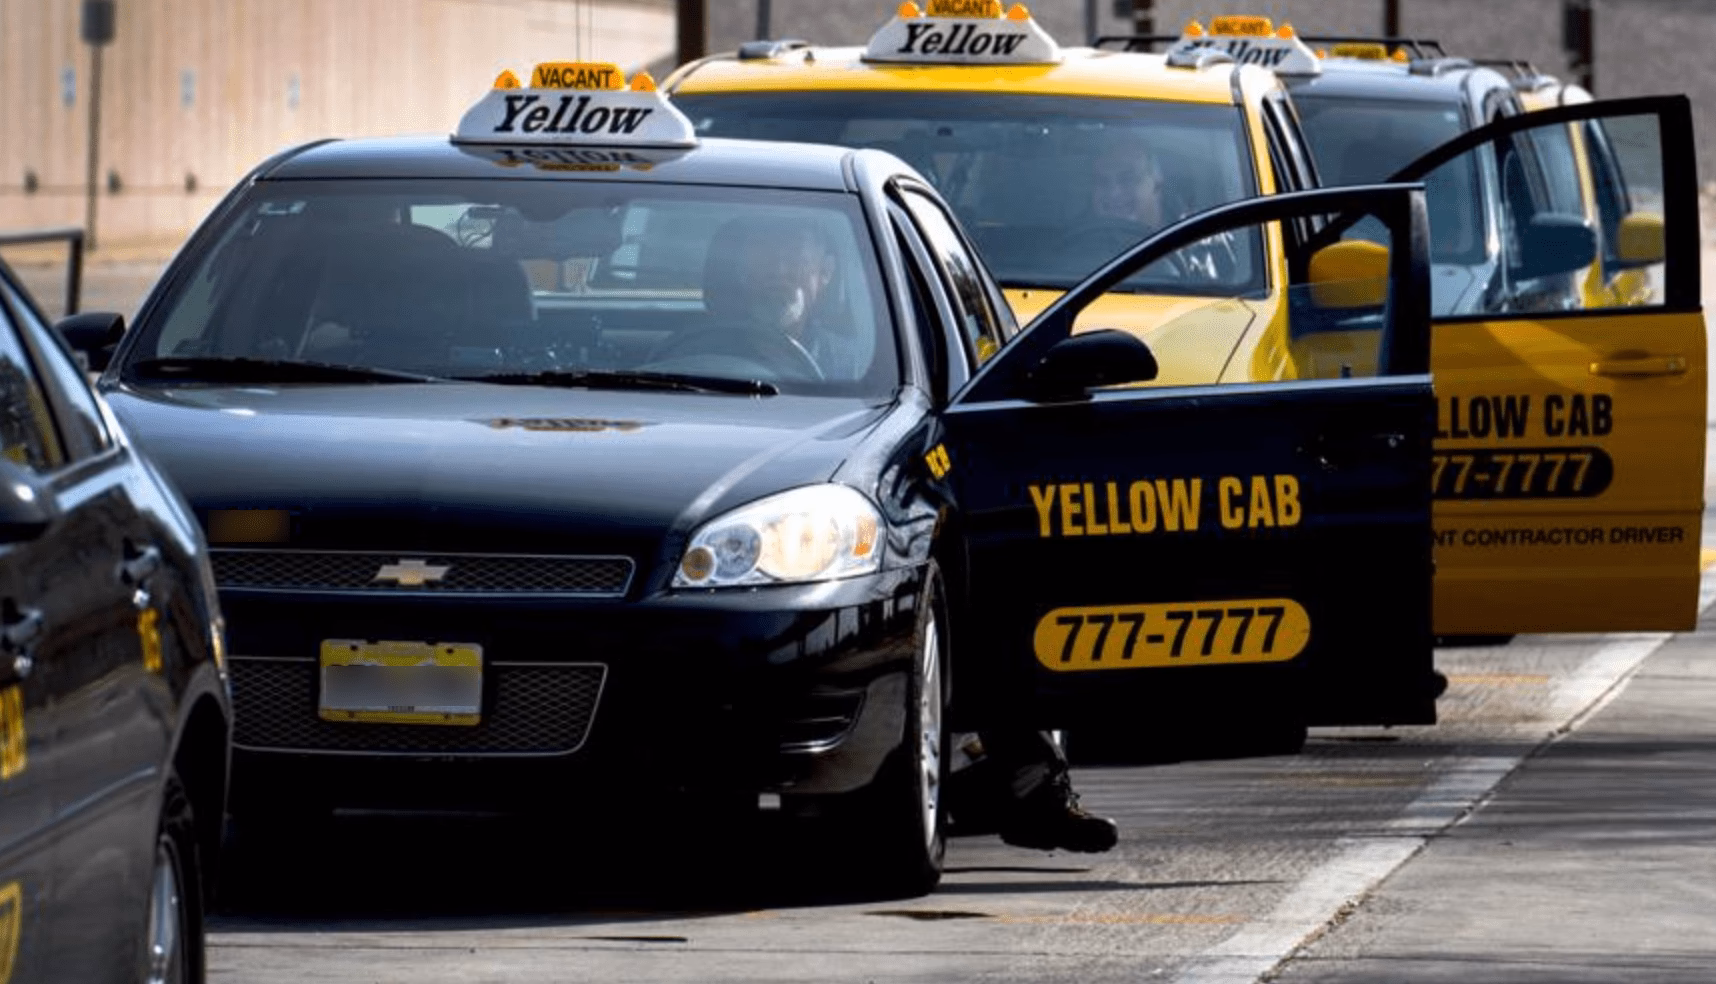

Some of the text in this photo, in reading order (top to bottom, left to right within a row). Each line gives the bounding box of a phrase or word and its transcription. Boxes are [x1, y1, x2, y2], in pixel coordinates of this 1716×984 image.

[897, 22, 1028, 56] Yellow
[539, 67, 615, 89] VACANT
[493, 94, 653, 134] Yellow
[1432, 393, 1614, 439] LLOW CAB
[1431, 453, 1594, 494] 77-7777
[1028, 473, 1302, 538] YELLOW CAB
[1461, 527, 1604, 547] CONTRACTOR
[1609, 525, 1685, 545] DRIVER
[1055, 605, 1286, 664] 777-7777
